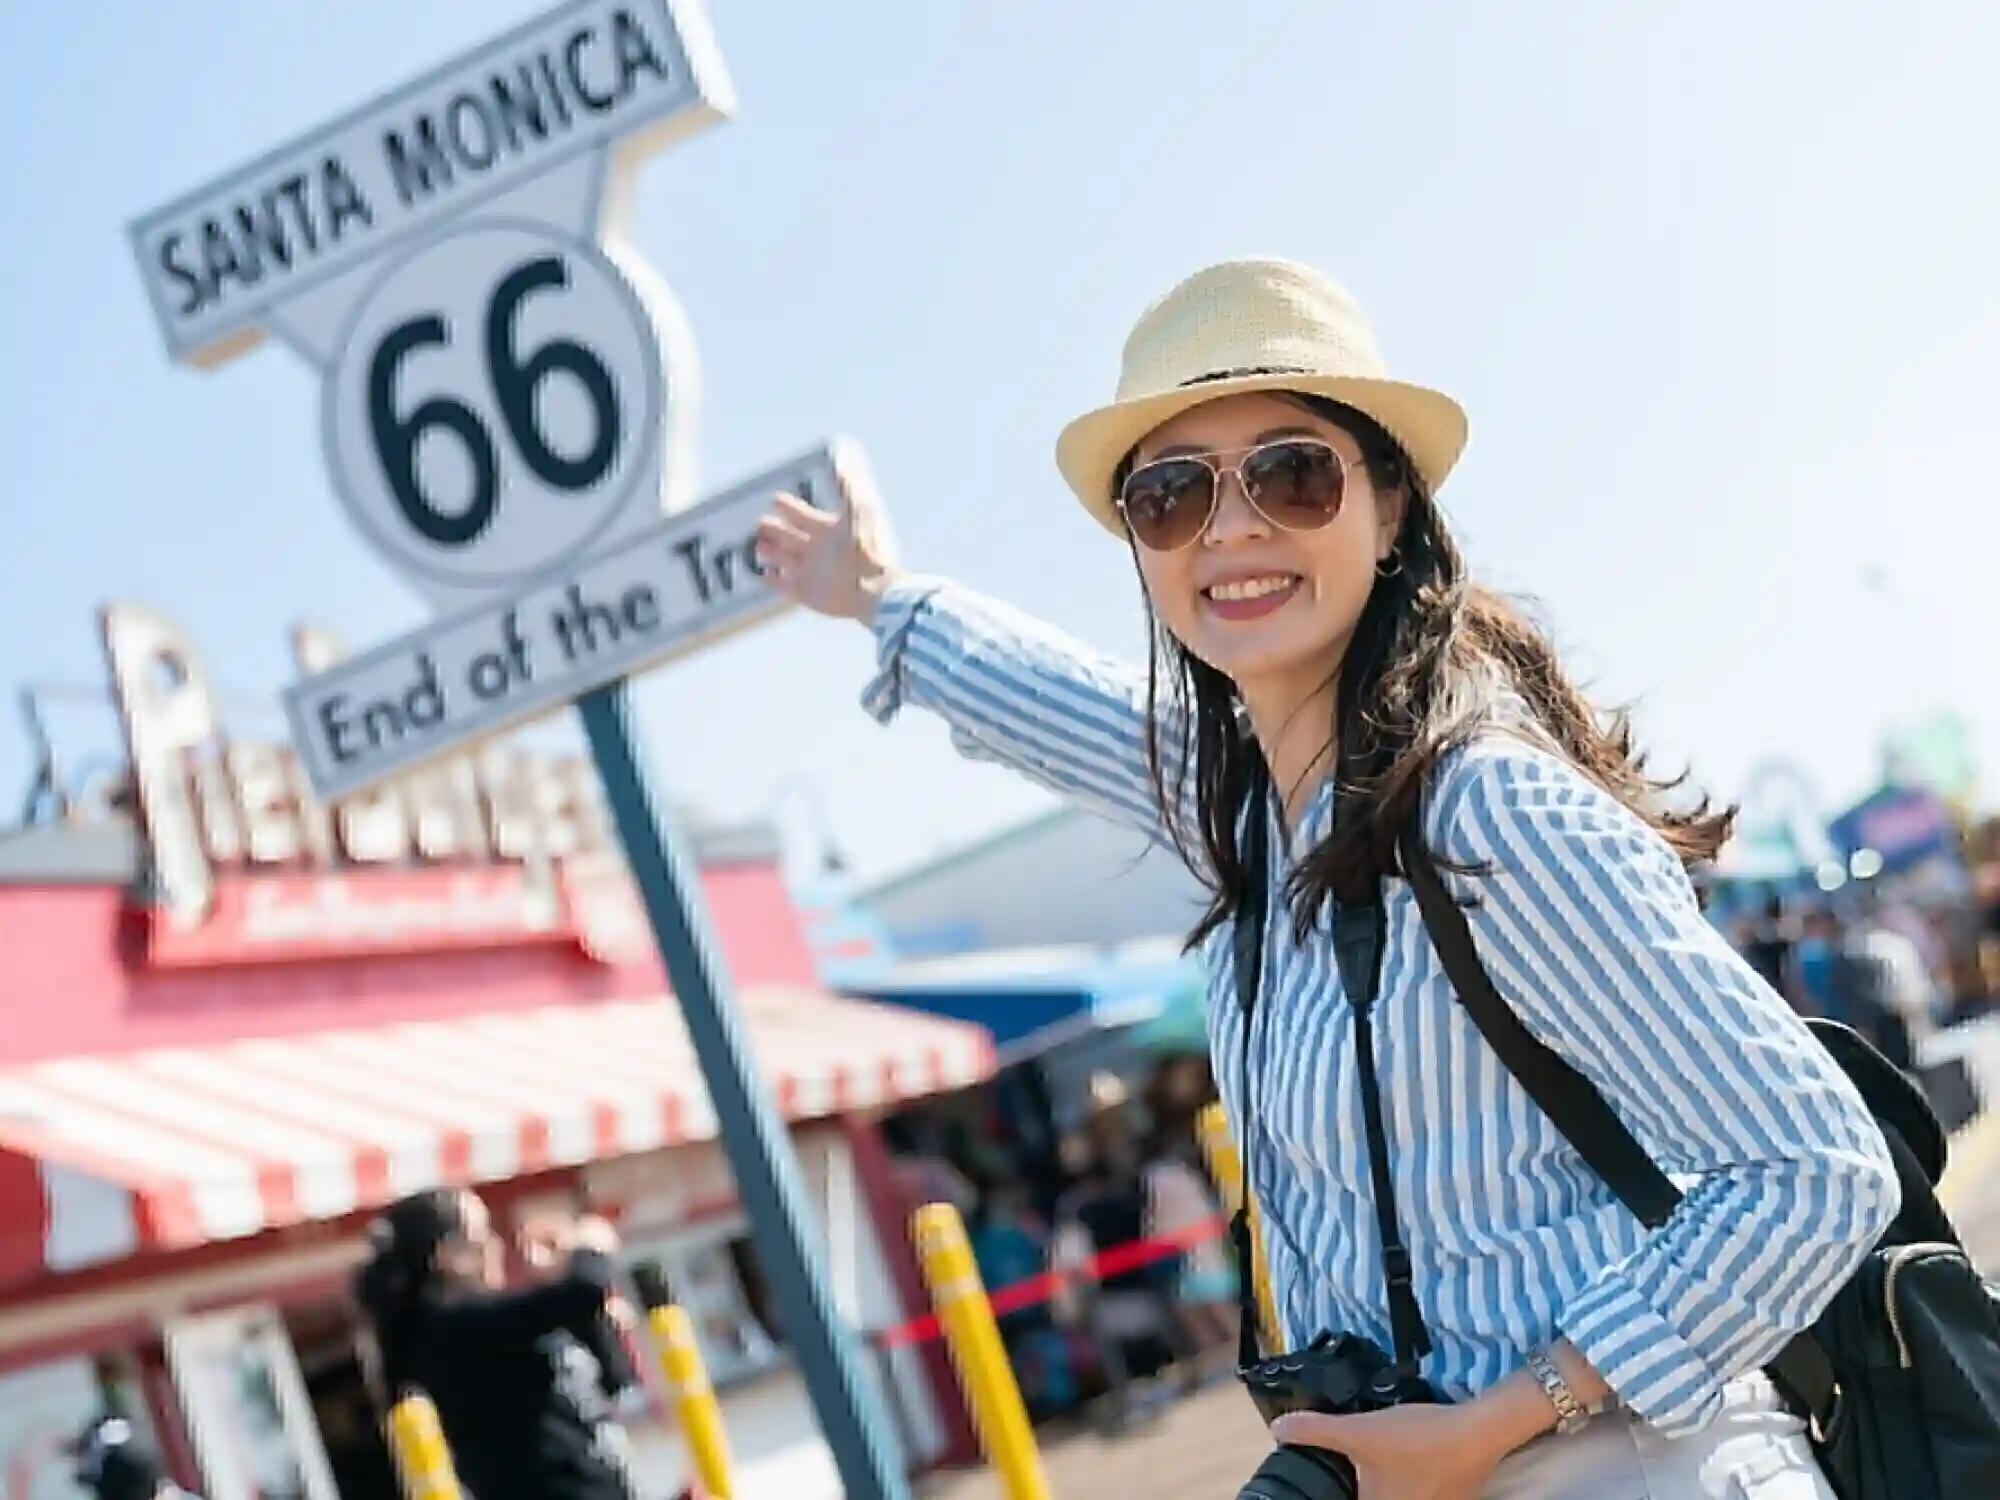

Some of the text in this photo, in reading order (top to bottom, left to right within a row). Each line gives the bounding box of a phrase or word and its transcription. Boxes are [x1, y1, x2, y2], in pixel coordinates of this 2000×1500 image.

[158, 8, 669, 316] SANTA MONICA
[366, 256, 621, 548] 66
[316, 651, 446, 765] End
[468, 608, 533, 699] of
[550, 583, 661, 660] the
